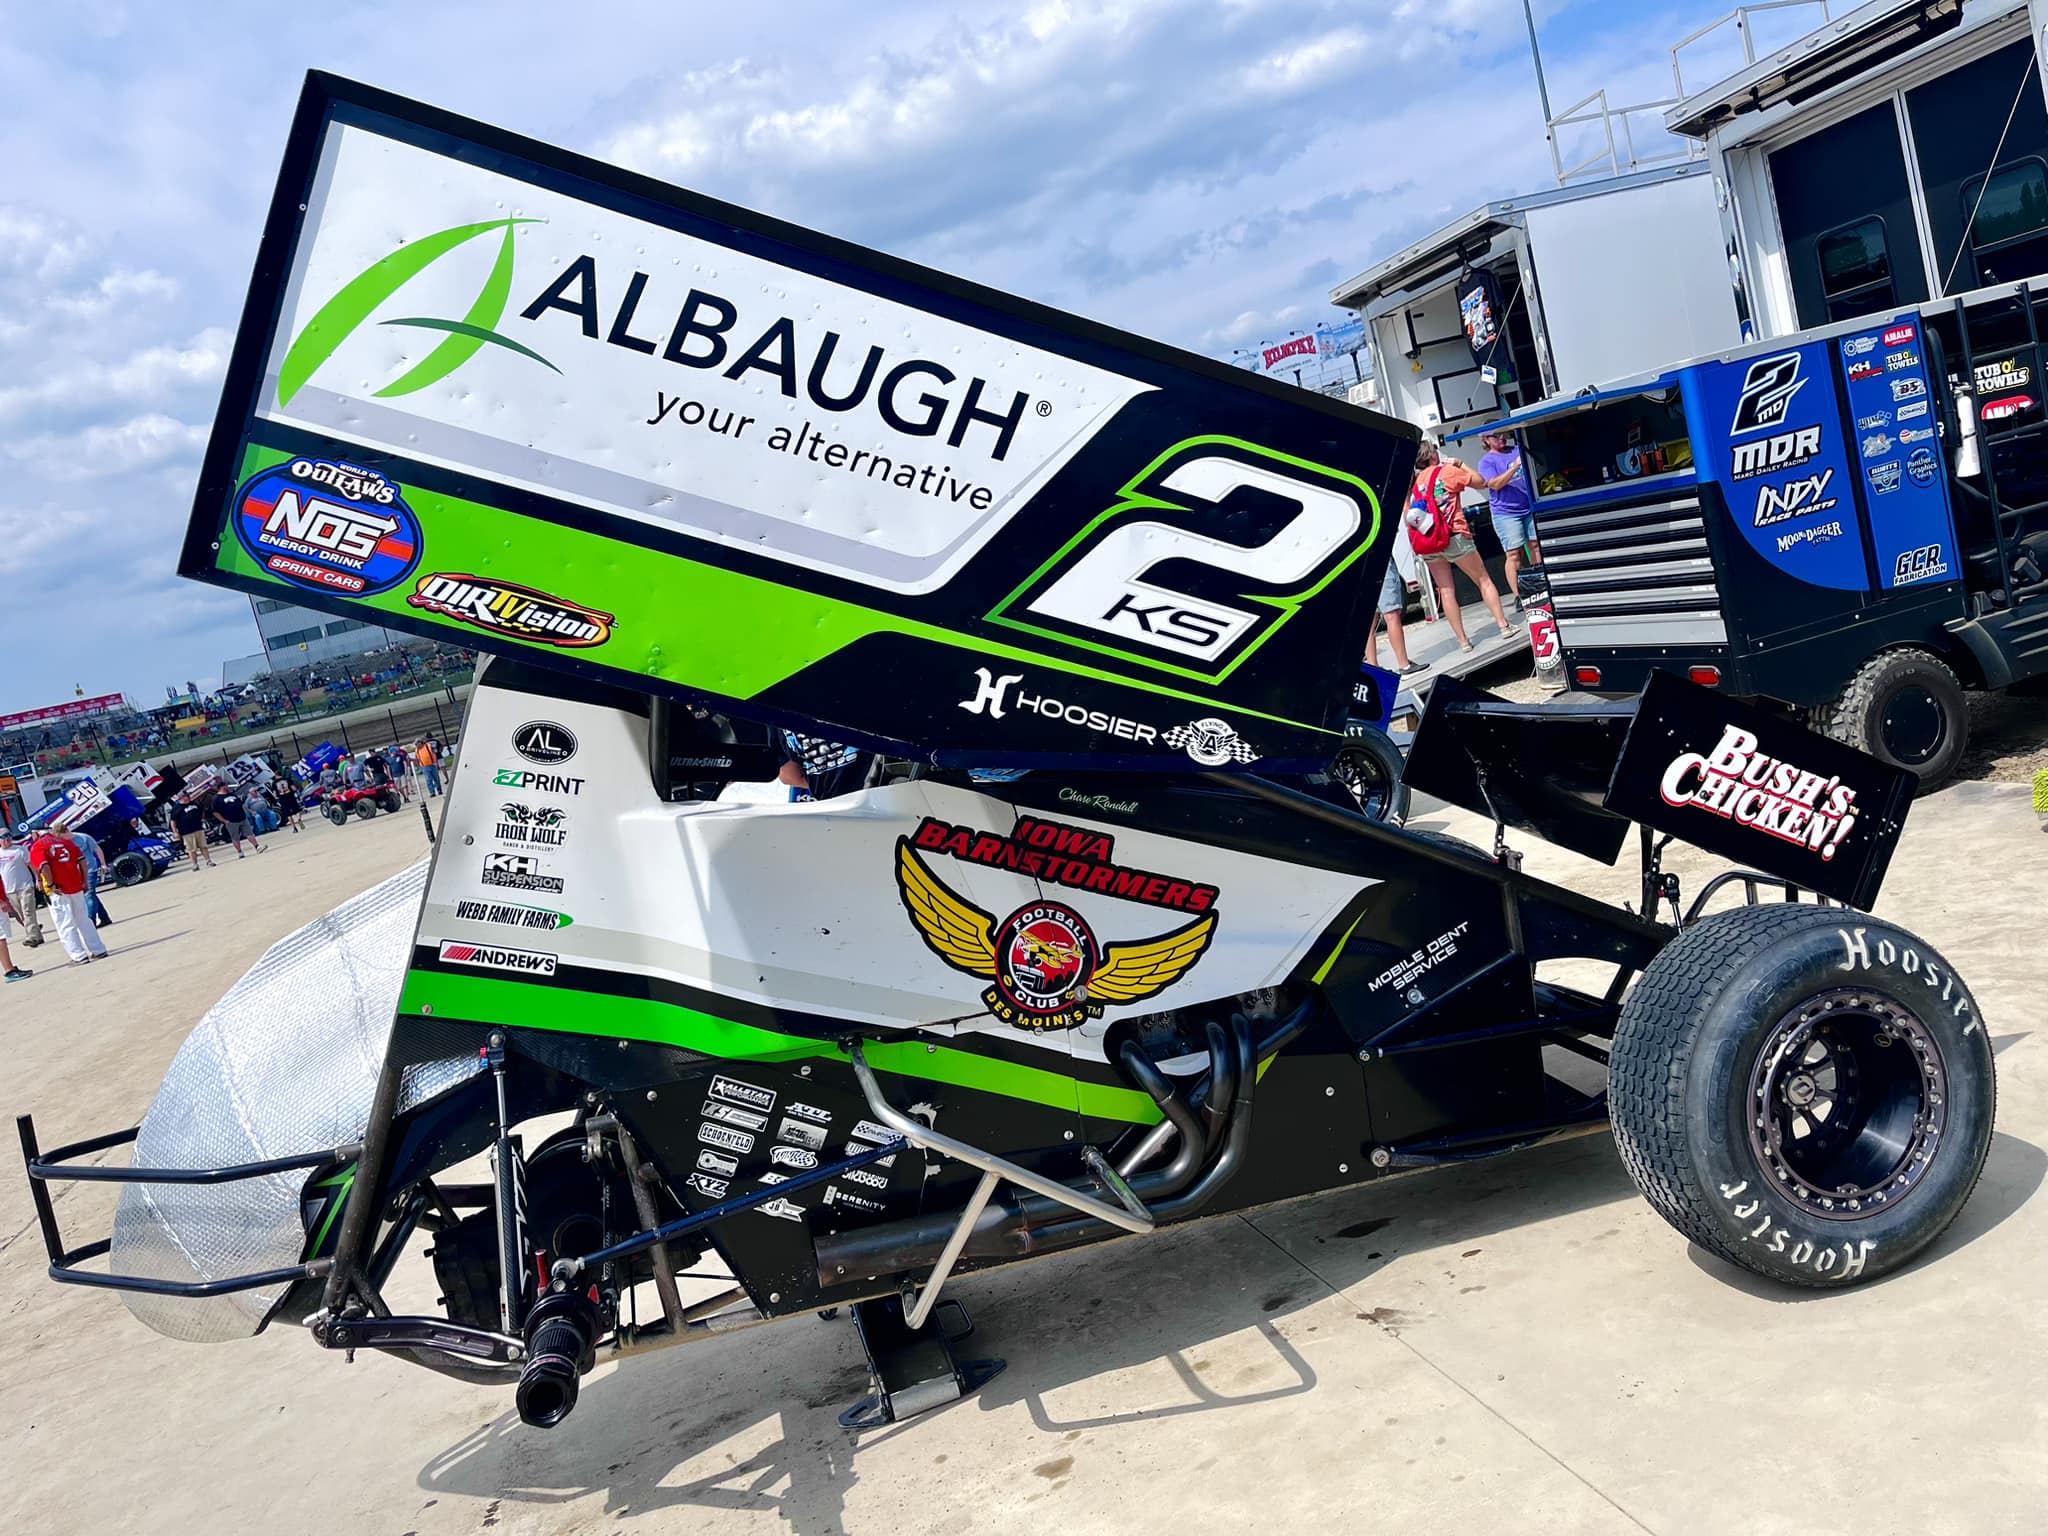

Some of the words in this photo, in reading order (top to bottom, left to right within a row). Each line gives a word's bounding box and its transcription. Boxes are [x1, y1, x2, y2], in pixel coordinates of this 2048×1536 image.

[1884, 327, 1913, 344] AMALIE
[1974, 363, 2002, 379] TUB
[1976, 370, 2027, 391] TOWELS
[647, 391, 754, 439] your
[767, 422, 993, 511] alternative
[1733, 426, 1820, 474] MDR
[339, 463, 368, 477] WORLD
[368, 472, 381, 480] OF
[1733, 470, 1754, 481] MARC
[1756, 463, 1782, 475] DAILEY
[1783, 456, 1809, 468] RACING
[1754, 468, 1833, 526] INDY
[1758, 511, 1792, 527] RACE
[1795, 499, 1837, 516] PARTS
[263, 490, 399, 559] NOS
[258, 533, 319, 556] ENERGY
[318, 550, 364, 570] DRINK
[1026, 456, 1361, 661] 2
[1896, 544, 1942, 577] GCR
[270, 558, 323, 579] SPRINT
[324, 572, 362, 590] CARS
[1894, 563, 1947, 586] FABRICATION
[1101, 592, 1232, 647] KS
[1016, 690, 1158, 746] HOOSIER
[1707, 723, 1857, 820] BUSH'S
[71, 781, 99, 804] 26
[1058, 787, 1092, 804] Chase
[1092, 795, 1139, 813] Randall
[1660, 752, 1855, 862] CHICKEN!
[494, 822, 529, 842] IRON
[530, 827, 568, 846] WOLF
[1014, 821, 1112, 861] IOWA
[483, 869, 564, 890] SUSPENSION
[484, 853, 537, 875] KH
[915, 823, 1216, 910] BARNSTORMERS
[455, 899, 488, 921] WEBB
[487, 902, 524, 926] FAMILY
[523, 909, 559, 931] FARMS
[1012, 908, 1088, 946] FOOTBALL
[468, 948, 556, 972] ANDREWS
[1367, 949, 1426, 992] MOBILE
[1426, 921, 1468, 954] DENT
[1392, 943, 1458, 991] SERVICE
[986, 990, 1013, 1019] DES
[1017, 1010, 1084, 1027] MOINES
[1014, 989, 1060, 1009] CLUB
[725, 1083, 772, 1100] ALLSTAR
[702, 1126, 752, 1149] SCHOENFELD
[686, 1172, 730, 1193] XYZ
[835, 1192, 887, 1211] SERENITY
